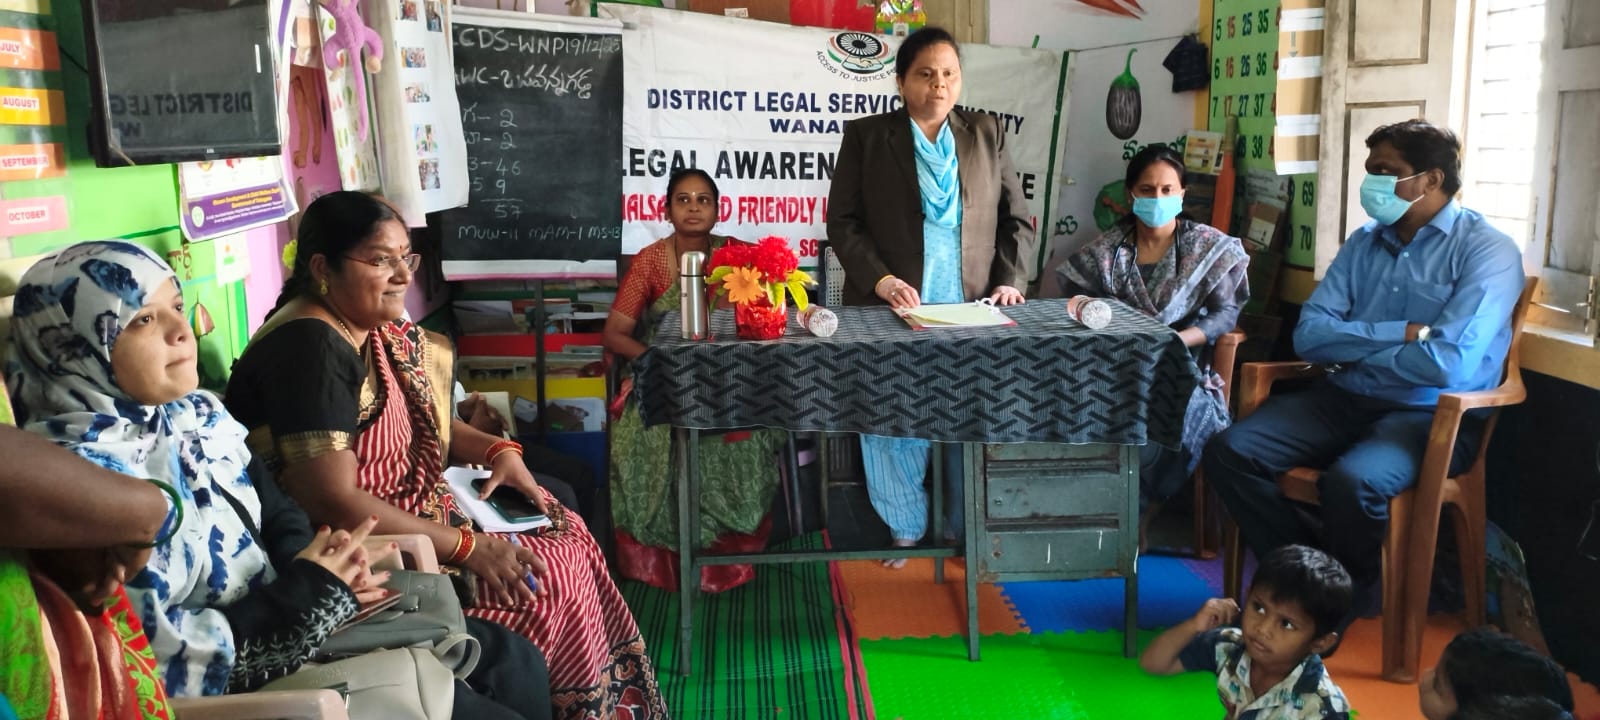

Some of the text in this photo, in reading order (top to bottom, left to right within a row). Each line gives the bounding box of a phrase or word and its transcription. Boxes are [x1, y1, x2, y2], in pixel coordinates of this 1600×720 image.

[1215, 18, 1222, 41] 5
[1227, 15, 1236, 39] 15
[1241, 11, 1252, 37] 25
[1257, 8, 1269, 34] 35
[1, 42, 20, 53] JULY
[816, 50, 839, 74] ACCESS
[839, 70, 850, 80] TO
[850, 72, 886, 82] JUSTICE
[1214, 57, 1220, 80] 6
[1225, 55, 1234, 79] 16
[1240, 53, 1251, 78] 26
[1255, 51, 1267, 76] 36
[3, 96, 37, 109] AUGUST
[647, 88, 902, 114] DISTRICT LEGAL SERVIC
[1212, 96, 1219, 118] 7
[1238, 94, 1249, 118] 27
[1254, 93, 1265, 117] 37
[769, 118, 847, 133] WANA
[1252, 135, 1263, 159] 38
[2, 156, 49, 168] SEPTEMBER
[714, 150, 835, 180] AWAREN
[495, 179, 506, 194] 9
[1303, 180, 1315, 207] 69
[9, 209, 46, 221] OCTOBER
[738, 196, 817, 226] FRIENDLY
[1301, 224, 1312, 250] 70
